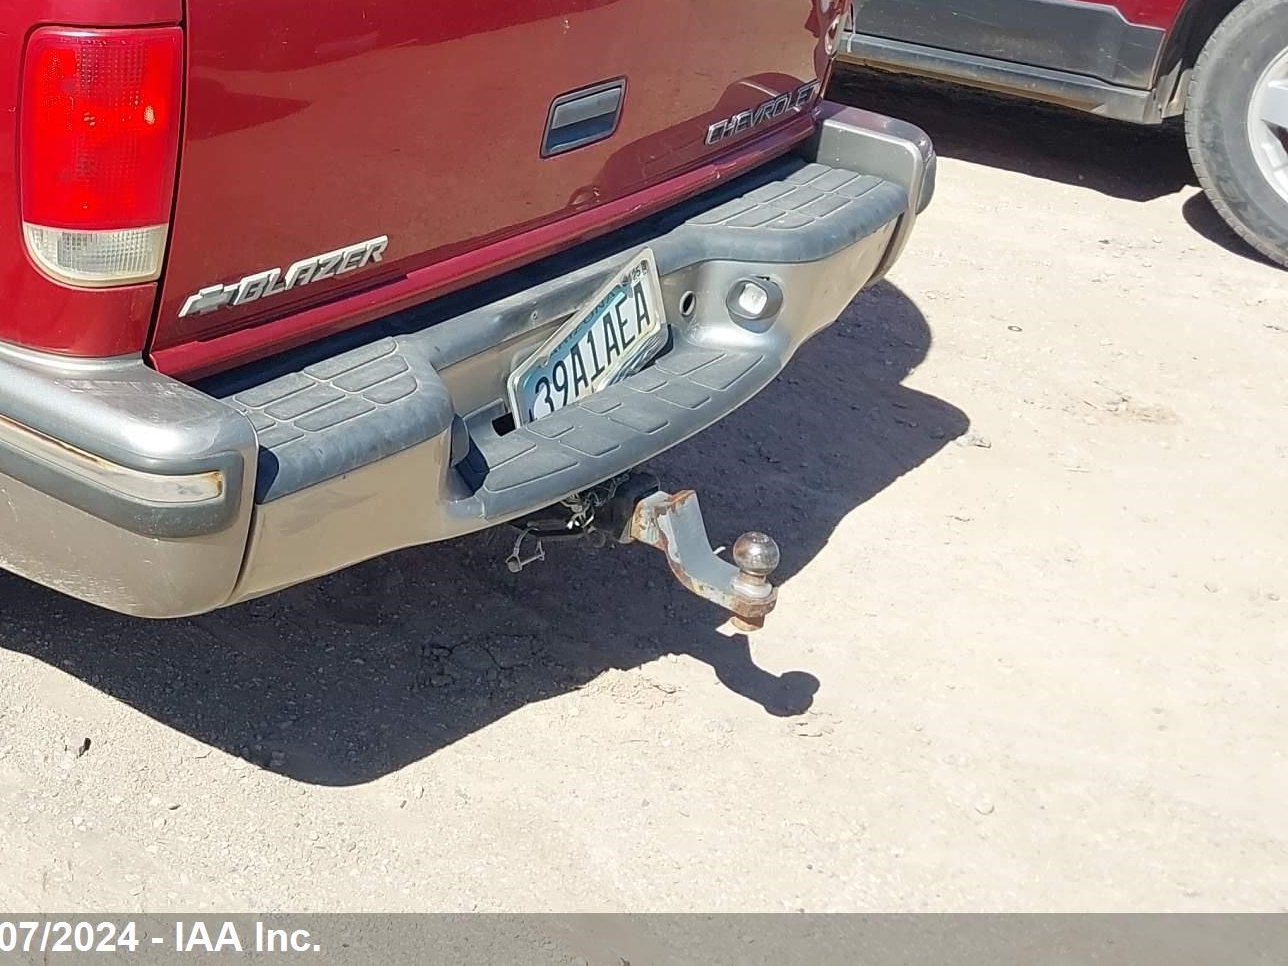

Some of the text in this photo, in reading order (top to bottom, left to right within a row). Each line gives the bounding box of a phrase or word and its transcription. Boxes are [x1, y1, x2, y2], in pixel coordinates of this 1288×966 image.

[705, 79, 821, 146] CHEVROLET
[233, 234, 389, 306] BLAZER
[535, 283, 651, 413] 39A1AEA
